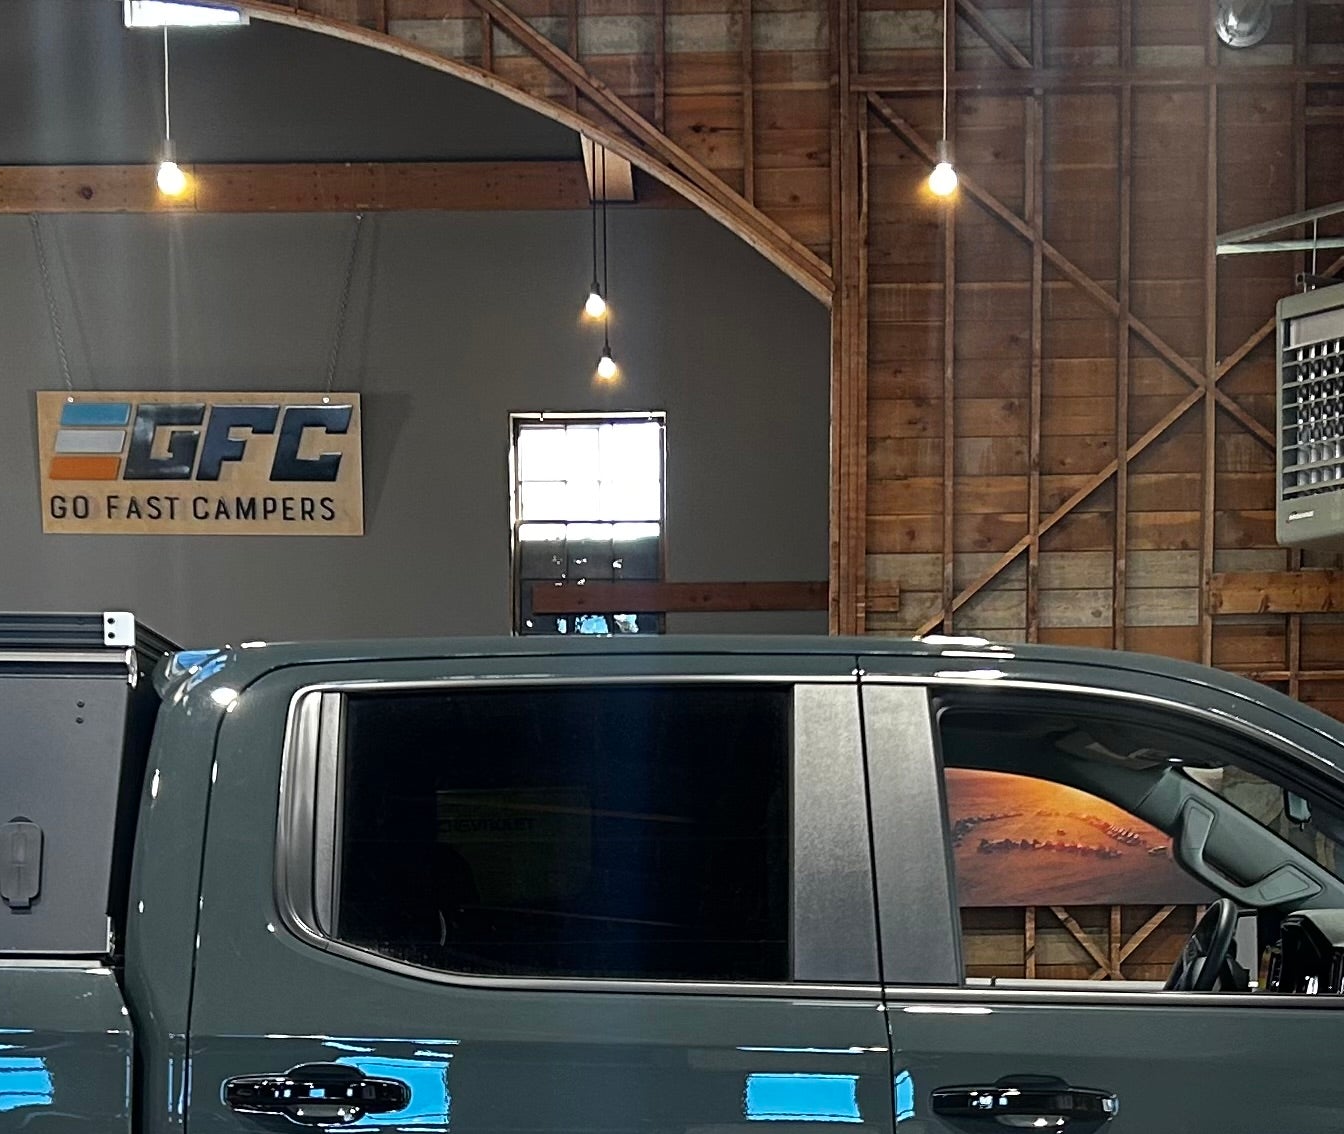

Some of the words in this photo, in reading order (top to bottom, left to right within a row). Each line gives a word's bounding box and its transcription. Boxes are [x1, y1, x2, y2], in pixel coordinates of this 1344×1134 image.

[123, 403, 353, 482] GFC
[50, 494, 90, 520] GO
[107, 494, 180, 521] FAST
[192, 495, 337, 521] CAMPERS
